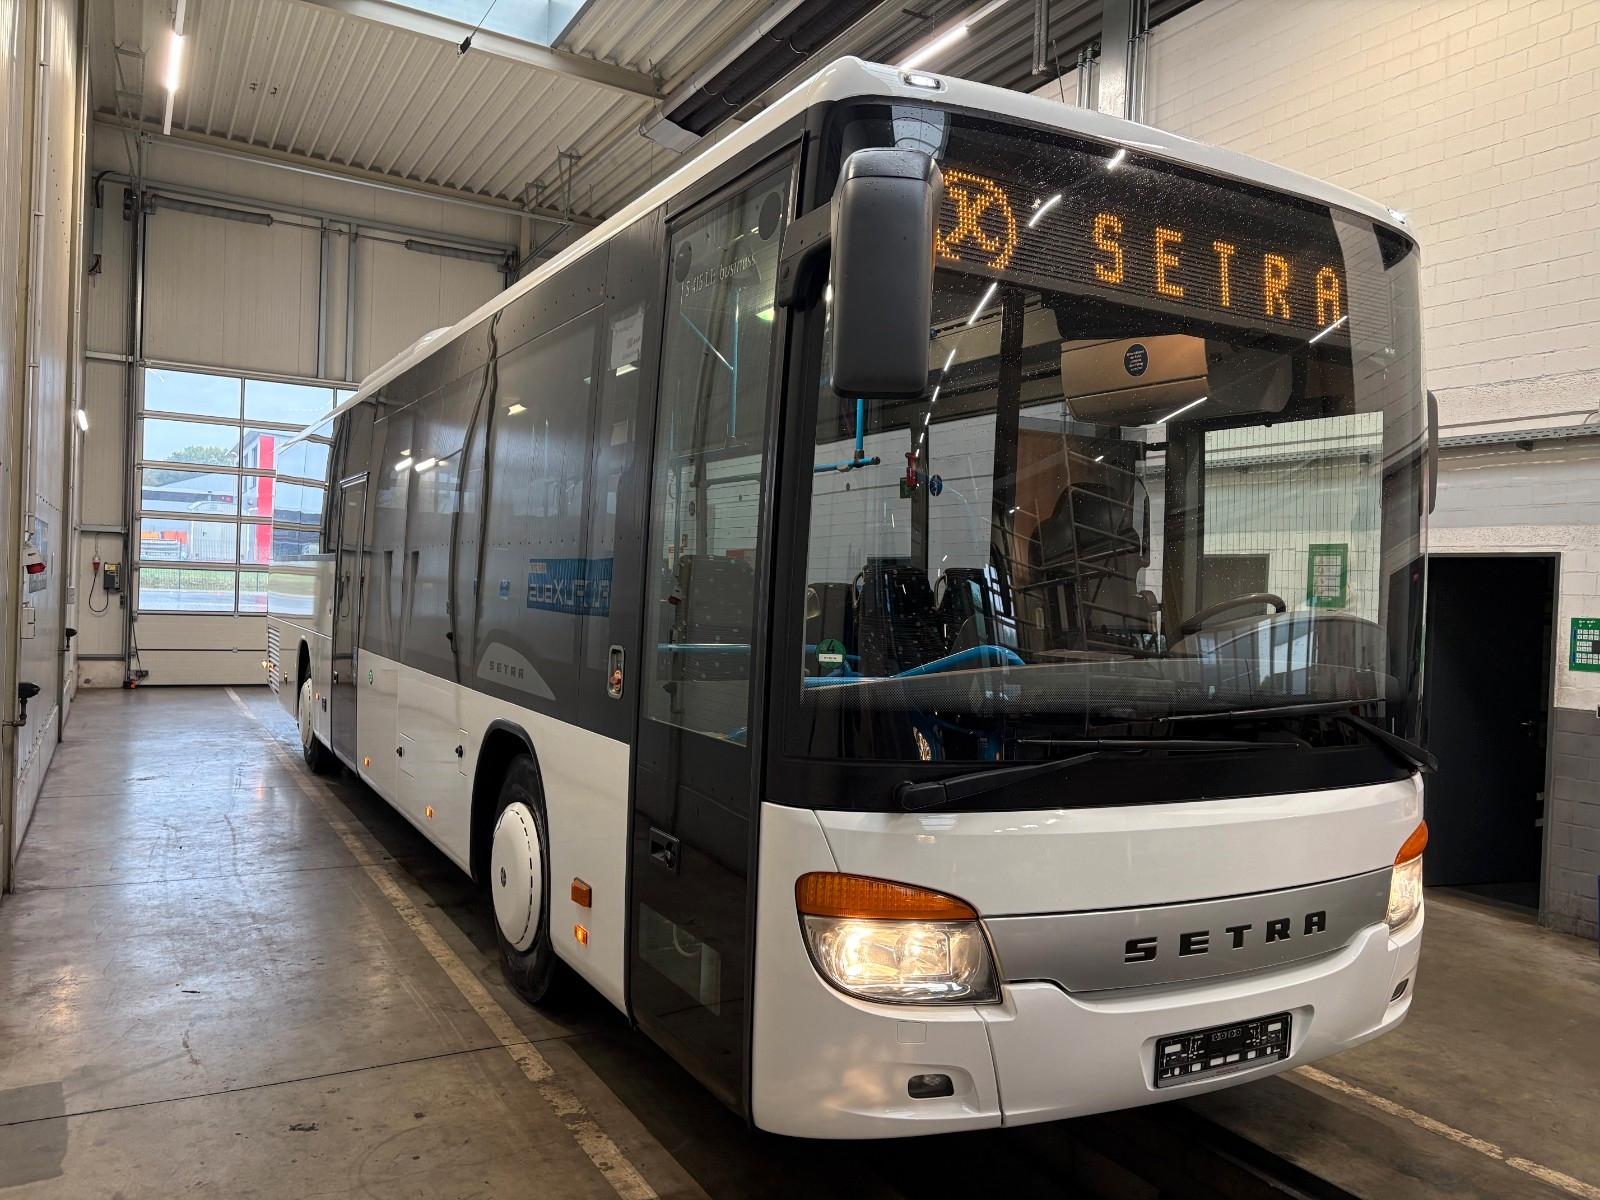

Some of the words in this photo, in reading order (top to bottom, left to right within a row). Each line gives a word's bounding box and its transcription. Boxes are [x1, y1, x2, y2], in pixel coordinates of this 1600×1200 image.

[1093, 211, 1342, 328] SETRA
[489, 660, 525, 680] SETRA
[1124, 910, 1327, 964] SETRA
